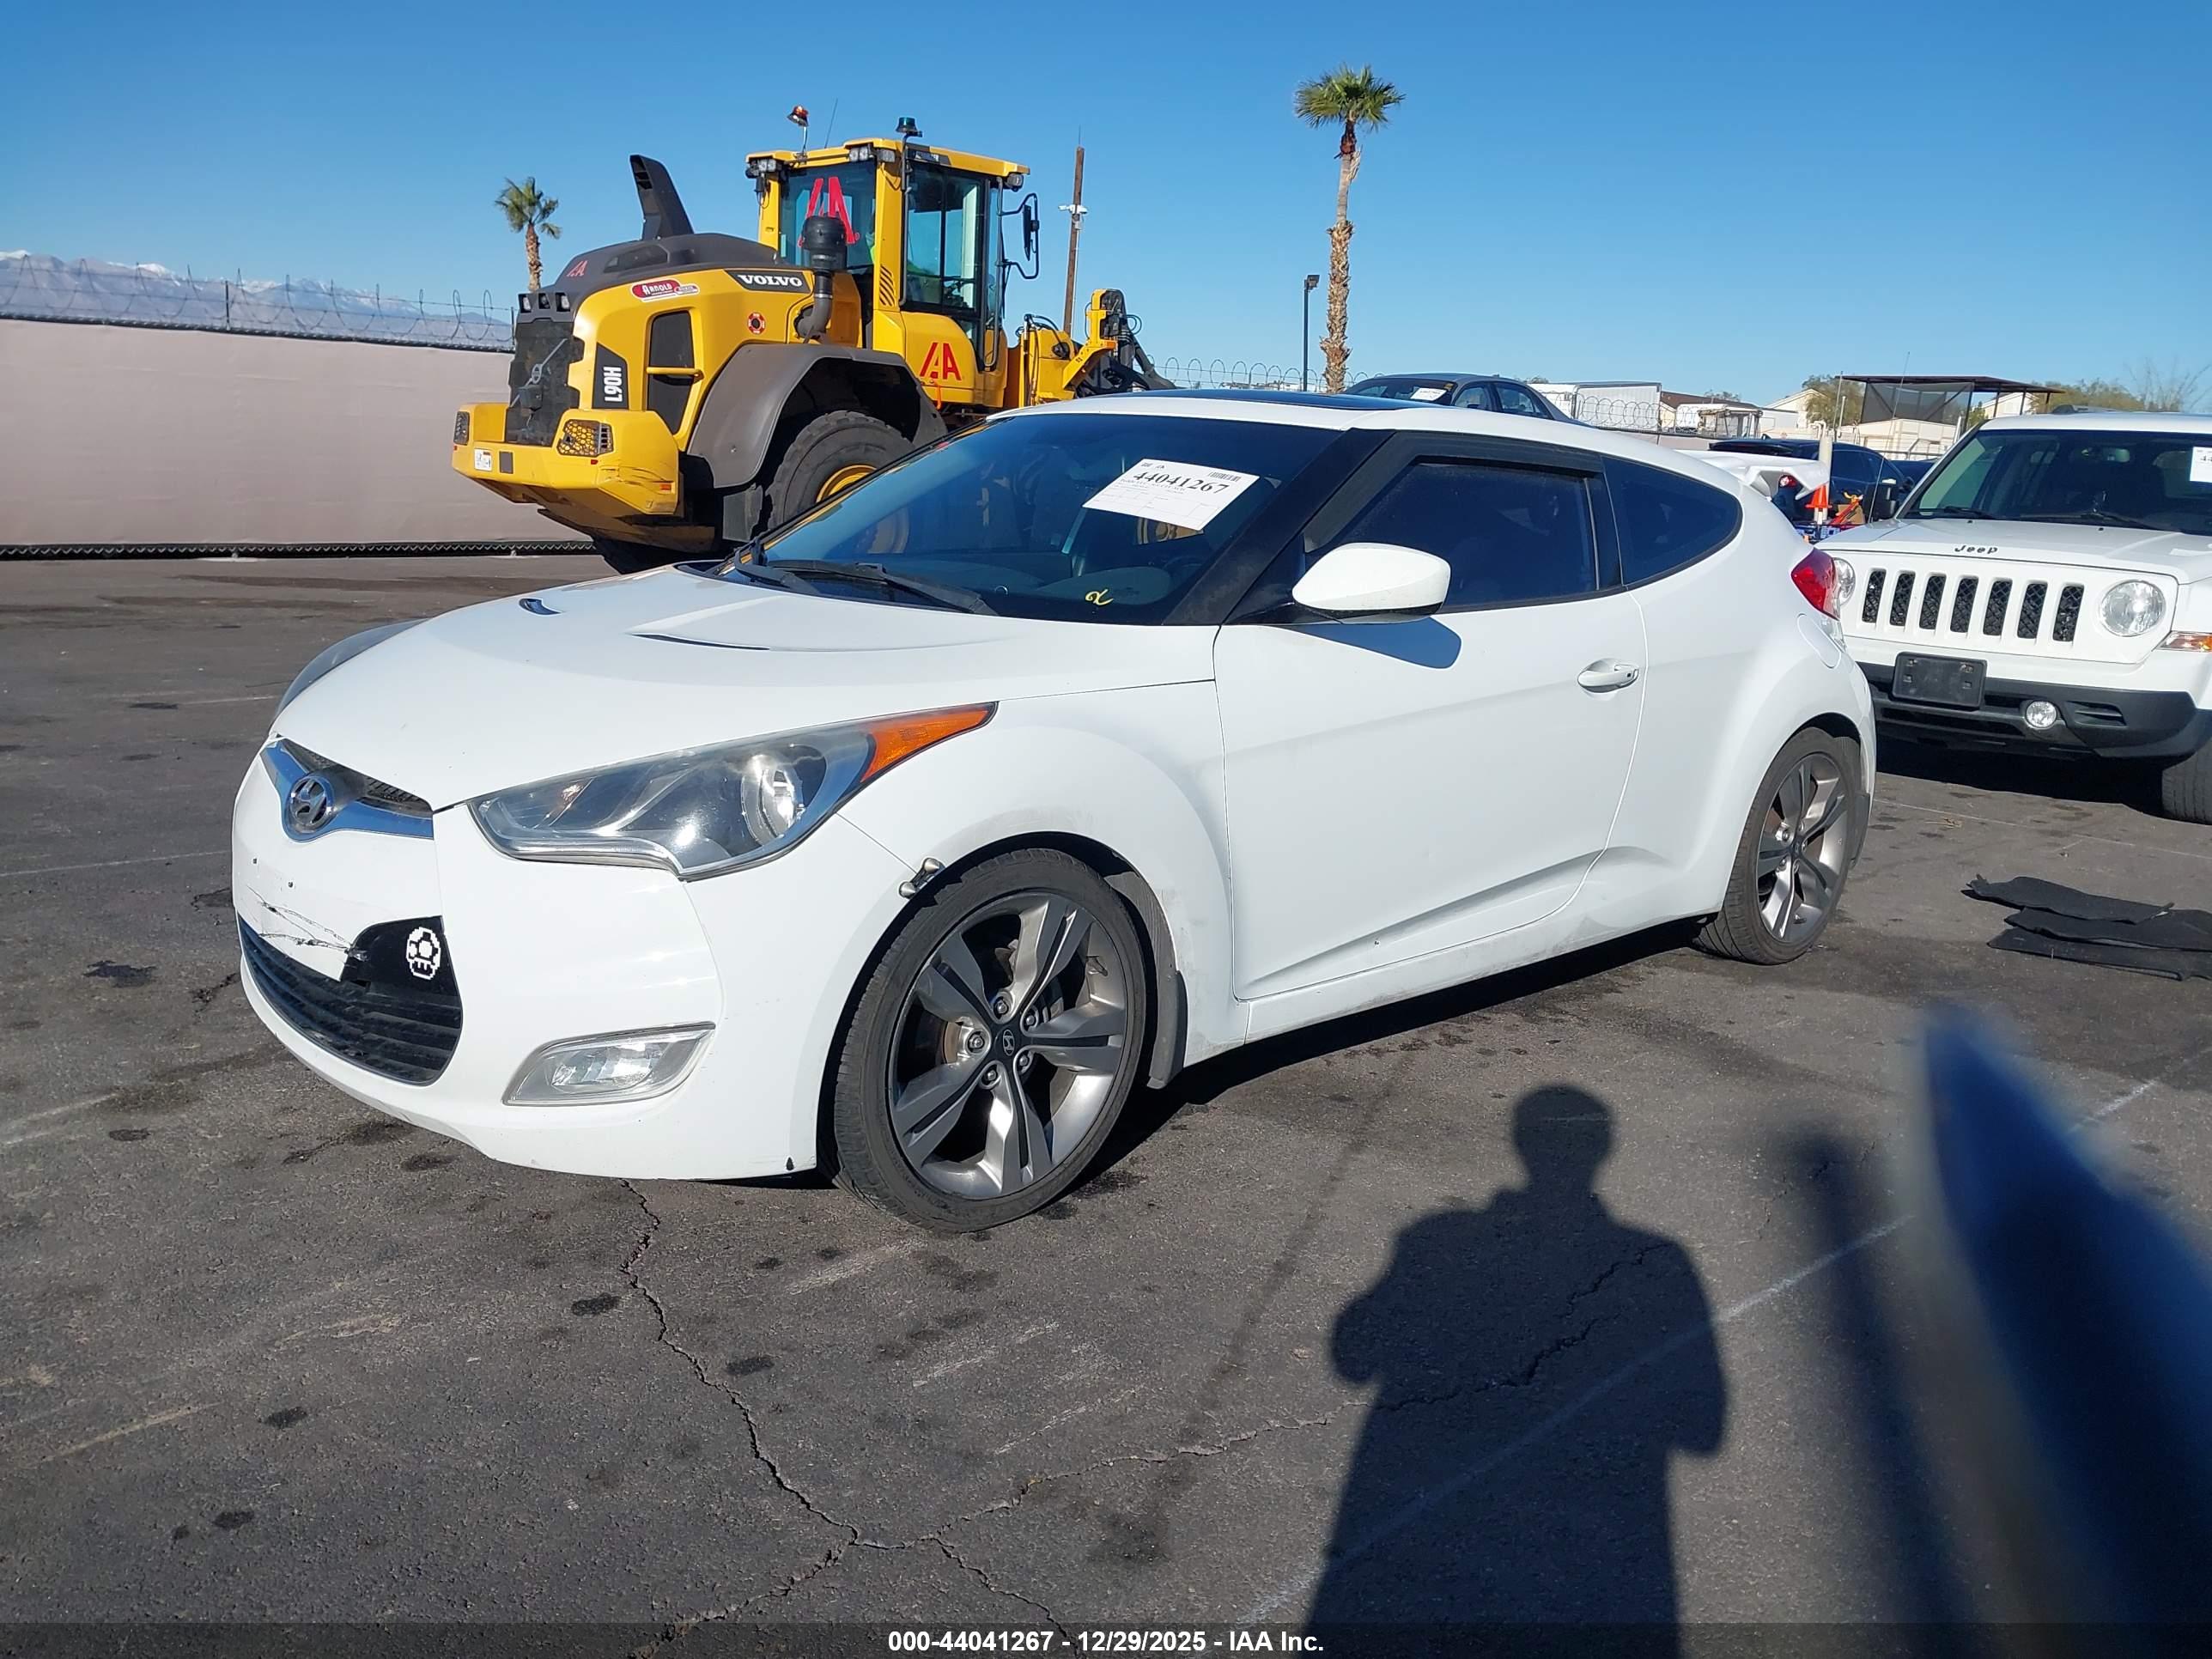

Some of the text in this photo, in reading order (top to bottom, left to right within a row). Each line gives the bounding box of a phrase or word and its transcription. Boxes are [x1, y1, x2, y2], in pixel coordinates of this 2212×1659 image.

[738, 274, 803, 288] VOLVO
[603, 366, 623, 403] L90H
[1133, 471, 1230, 495] 44041267
[1954, 544, 1998, 555] Jeep
